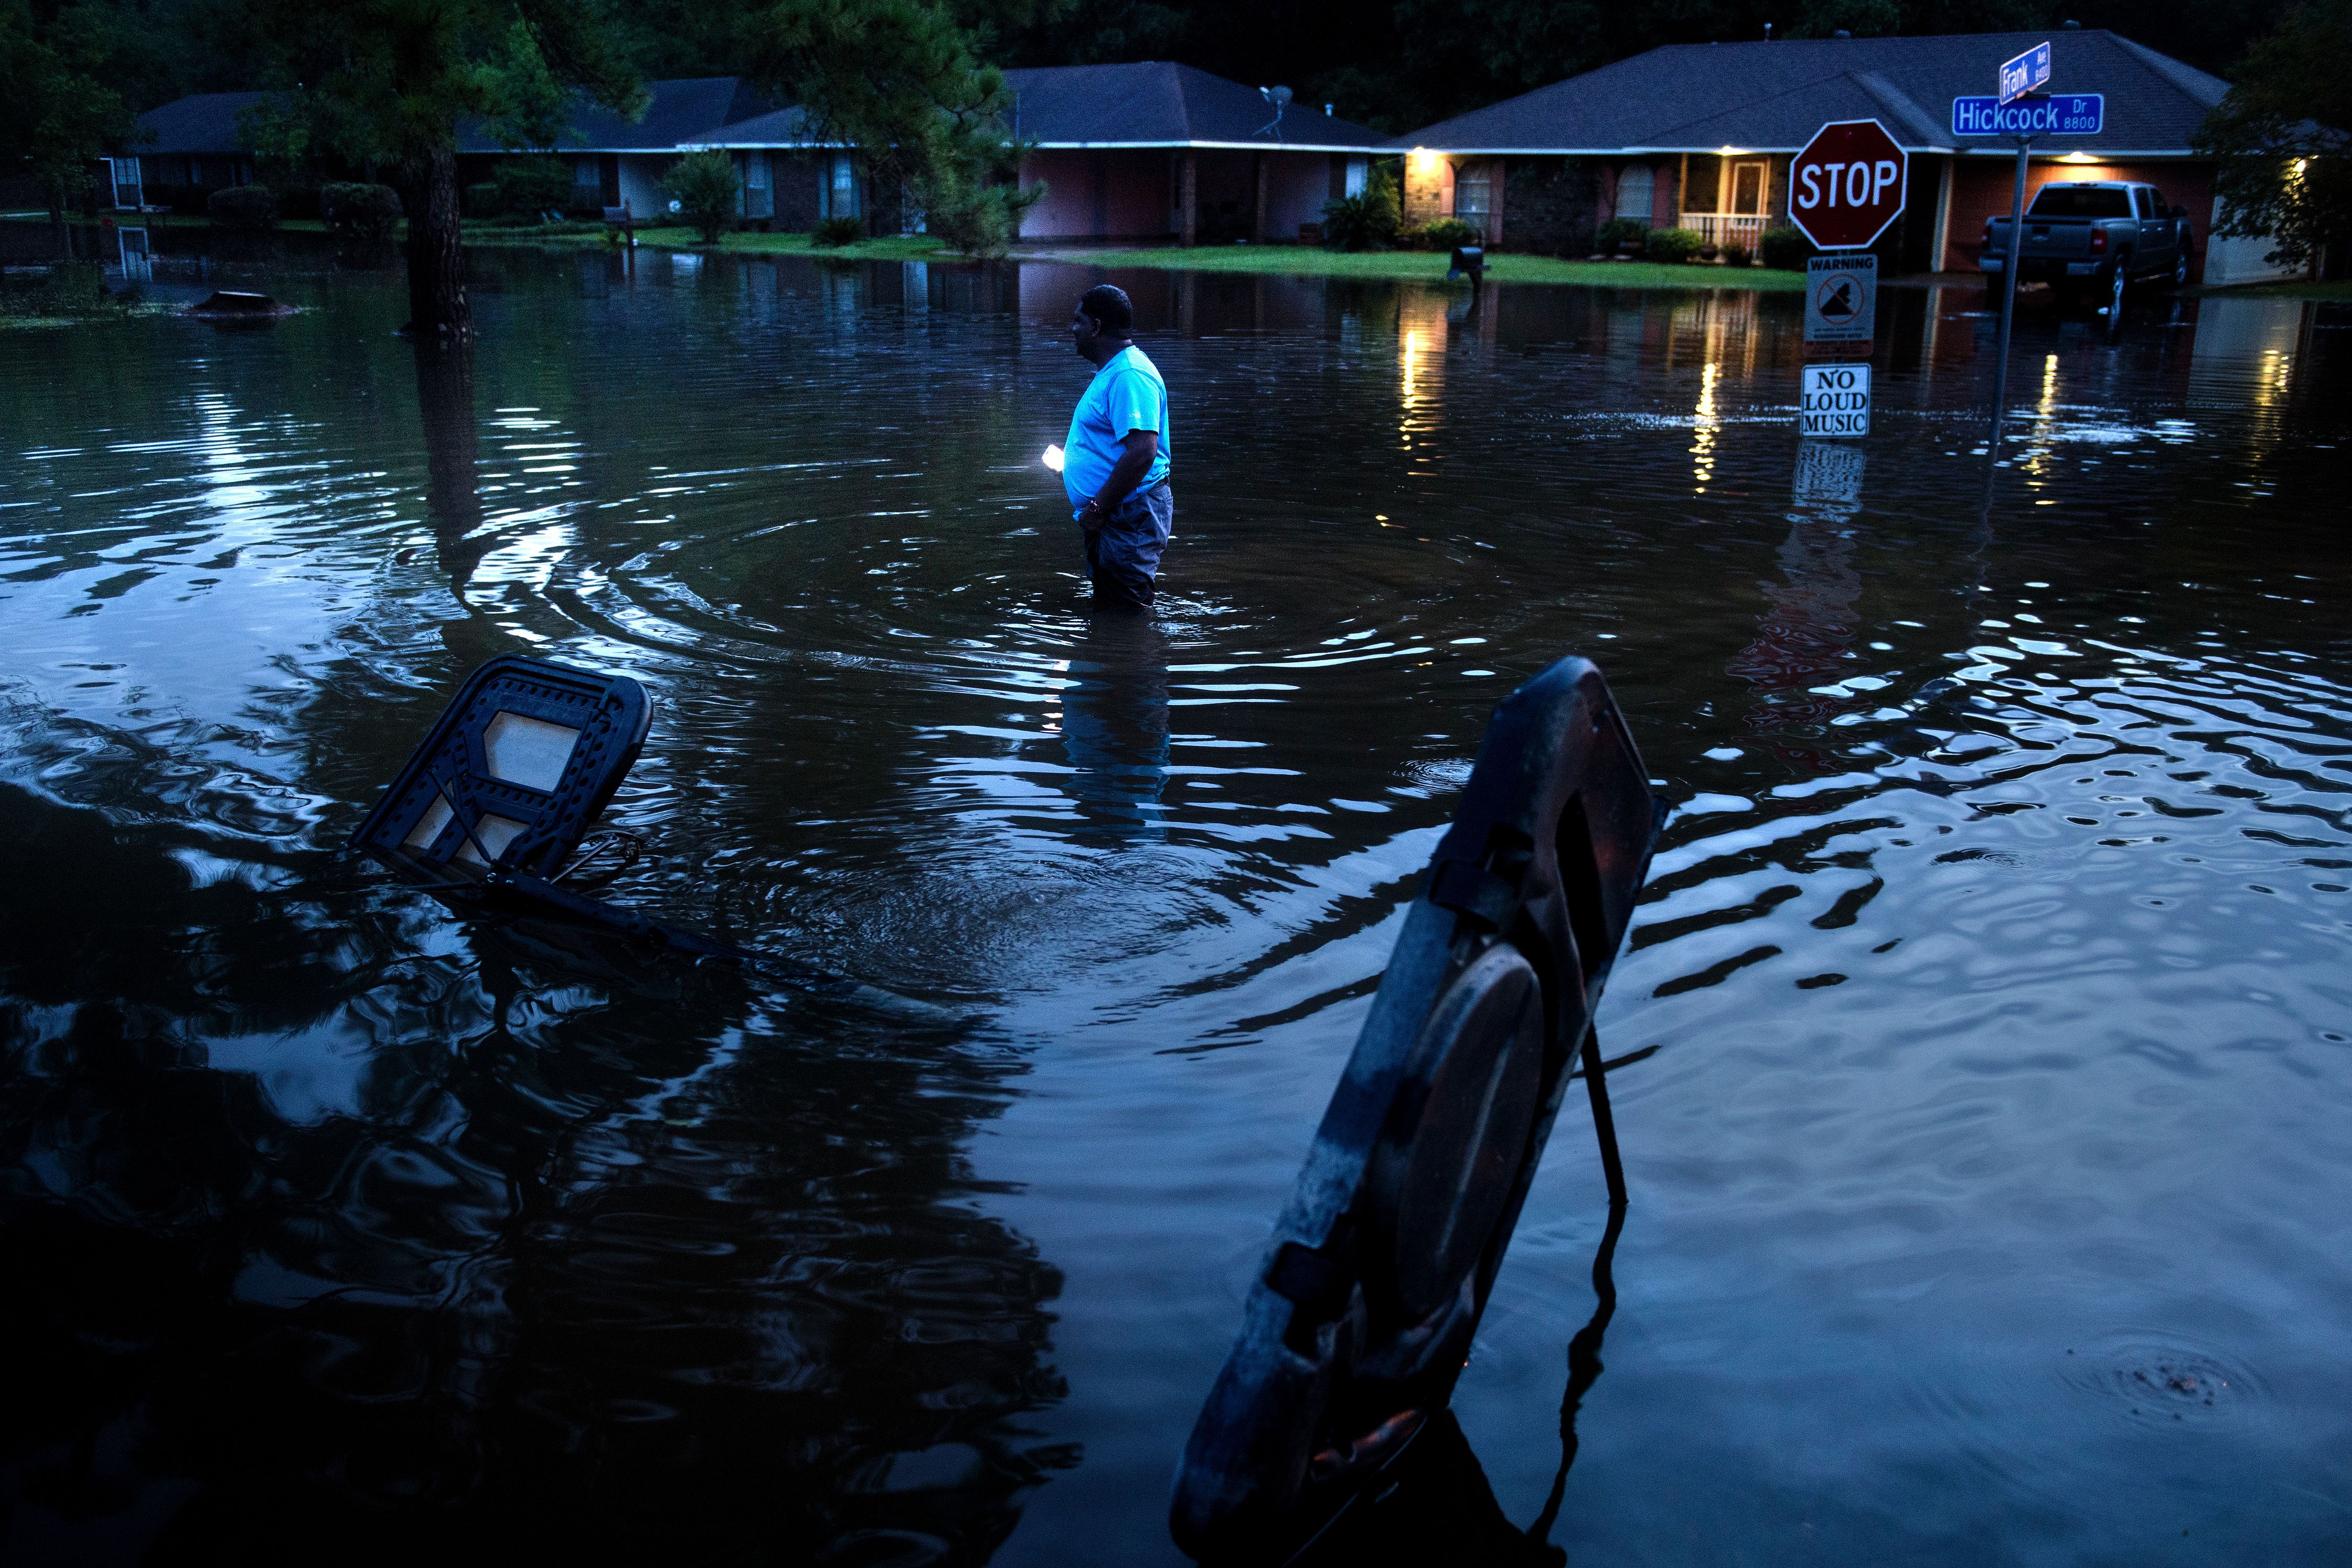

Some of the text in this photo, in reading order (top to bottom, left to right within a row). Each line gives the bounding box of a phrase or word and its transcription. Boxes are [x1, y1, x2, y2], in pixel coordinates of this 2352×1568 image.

[2003, 60, 2028, 98] Frank
[1959, 99, 2087, 130] Hickcock Dr
[2065, 117, 2095, 129] 8800
[1797, 160, 1898, 209] STOP
[1811, 257, 1873, 271] WARNING
[1817, 370, 1855, 389] NO
[1805, 393, 1866, 411] LOUD
[1804, 414, 1865, 432] MUSIC
